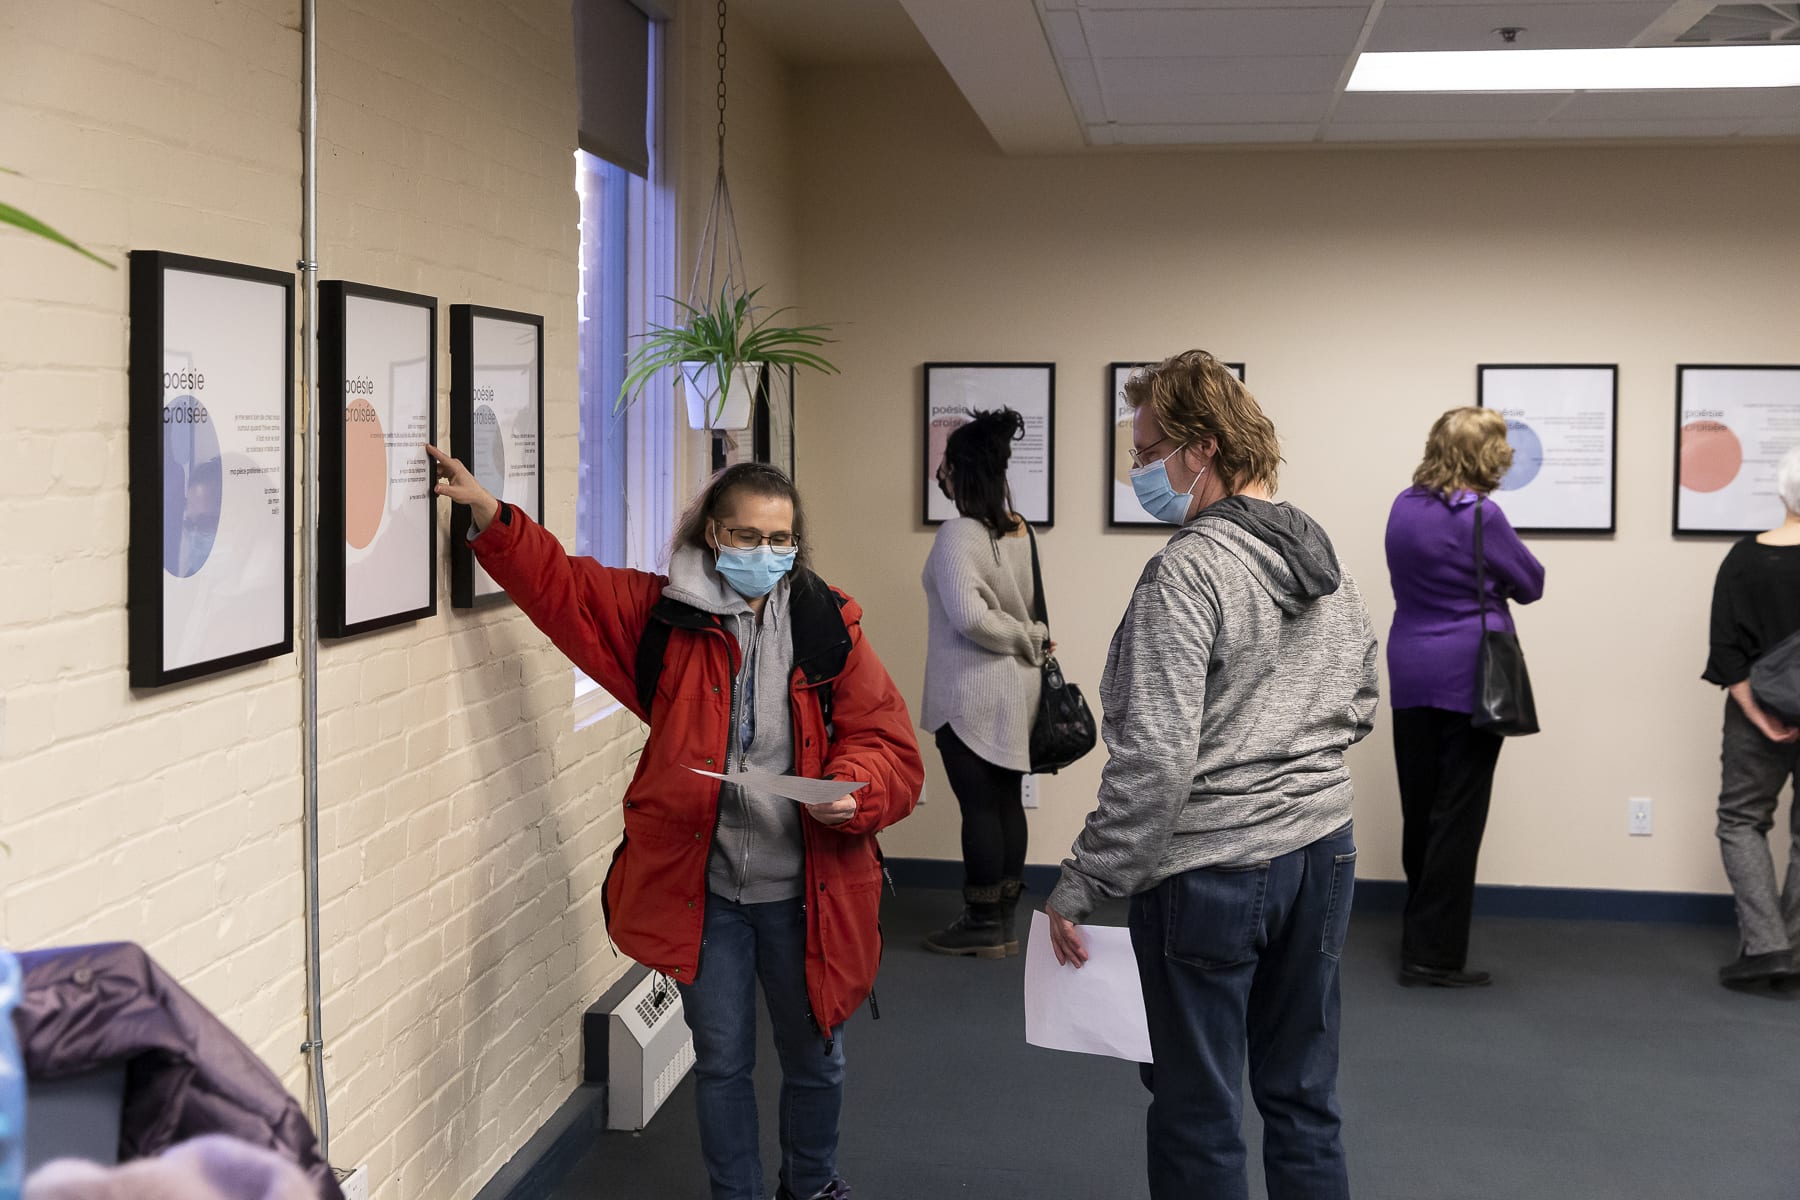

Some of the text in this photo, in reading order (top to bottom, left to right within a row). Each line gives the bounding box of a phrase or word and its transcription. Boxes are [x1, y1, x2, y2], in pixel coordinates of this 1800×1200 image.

[163, 402, 208, 424] croisée
[345, 403, 376, 423] croisée
[1503, 407, 1525, 416] ésie
[932, 417, 970, 428] crois
